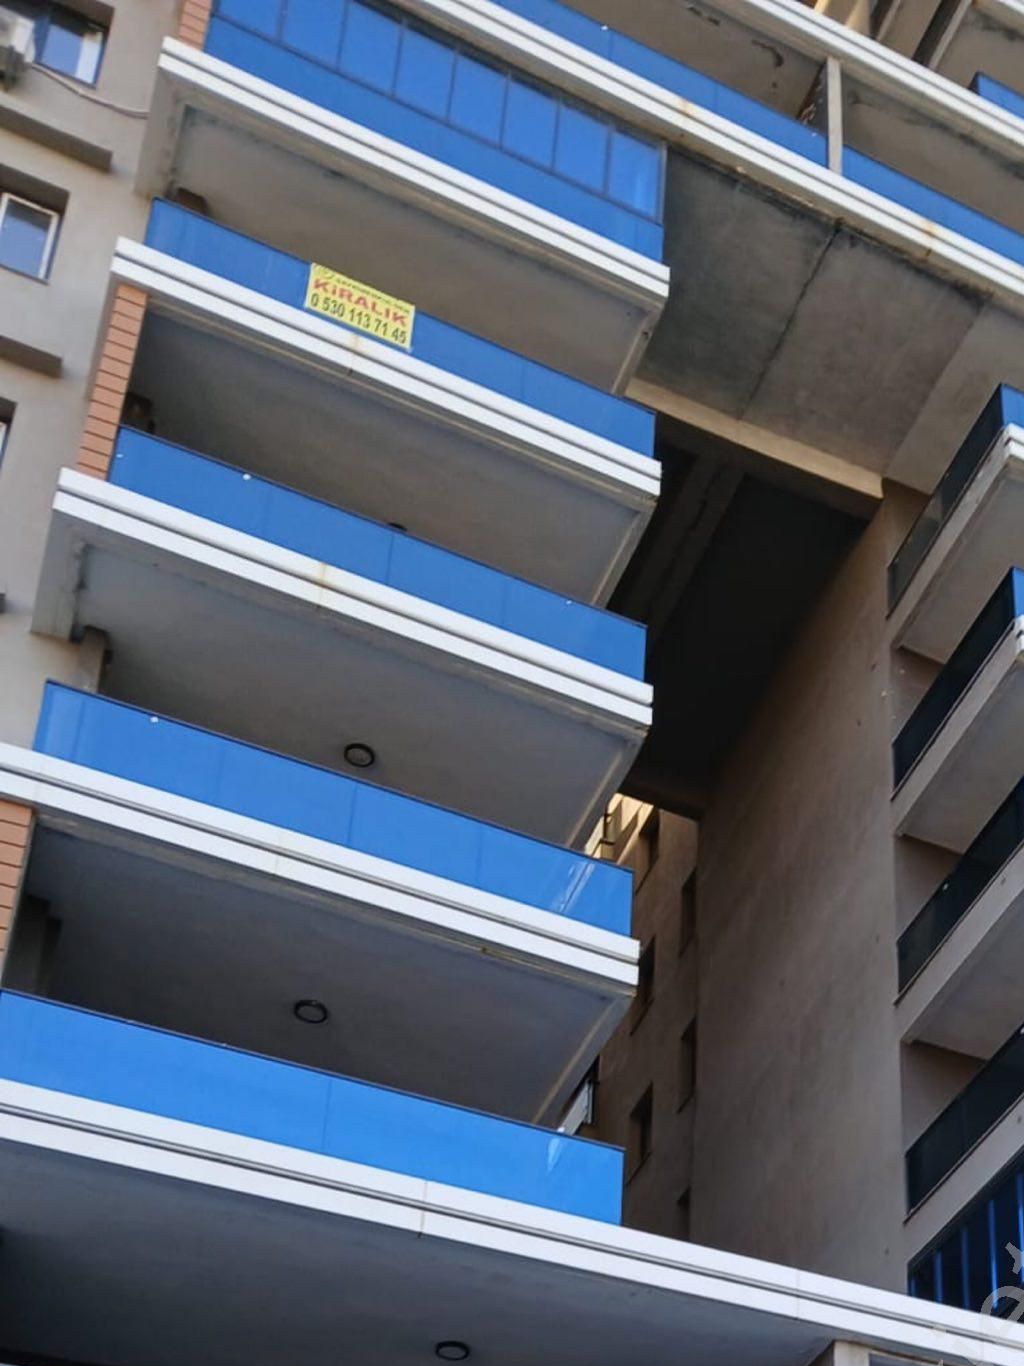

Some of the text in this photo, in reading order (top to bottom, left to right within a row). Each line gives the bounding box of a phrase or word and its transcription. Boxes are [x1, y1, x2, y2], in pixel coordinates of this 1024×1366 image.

[310, 292, 319, 308] 0
[374, 318, 388, 337] 71
[391, 327, 407, 345] 45
